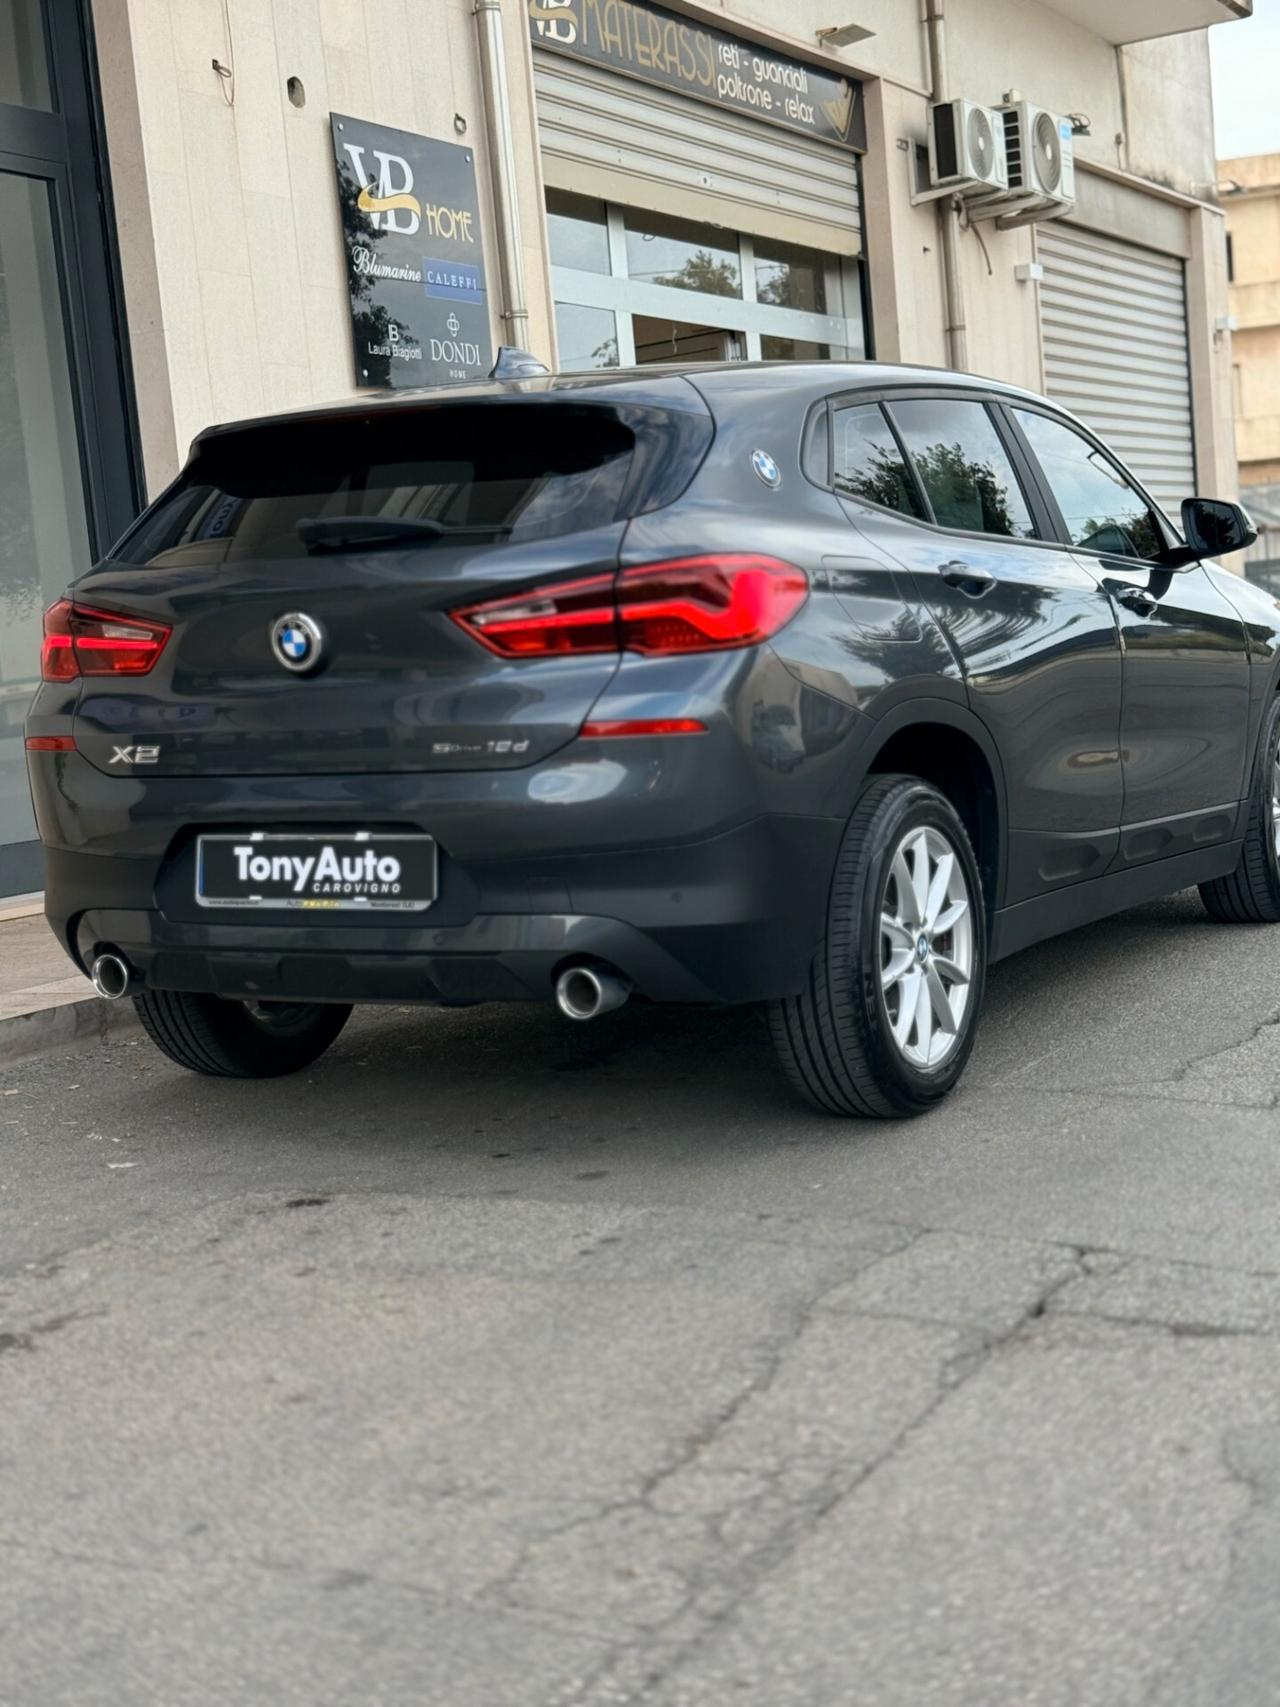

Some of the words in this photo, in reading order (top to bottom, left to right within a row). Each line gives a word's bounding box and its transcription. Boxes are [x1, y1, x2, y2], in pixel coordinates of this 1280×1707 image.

[582, 0, 717, 90] MATERASSI
[718, 43, 740, 70] reti
[752, 57, 809, 95] guanciali
[717, 72, 773, 110] poltrone
[785, 94, 815, 125] relax
[426, 203, 475, 243] HOME
[352, 245, 422, 282] Blumarine
[427, 271, 478, 290] CALEFFI
[368, 341, 391, 356] Laura
[388, 324, 400, 341] B
[429, 339, 482, 366] DONDI
[107, 745, 160, 764] X2
[233, 846, 401, 892] TonyAuto
[312, 883, 401, 893] CAROVIGNO
